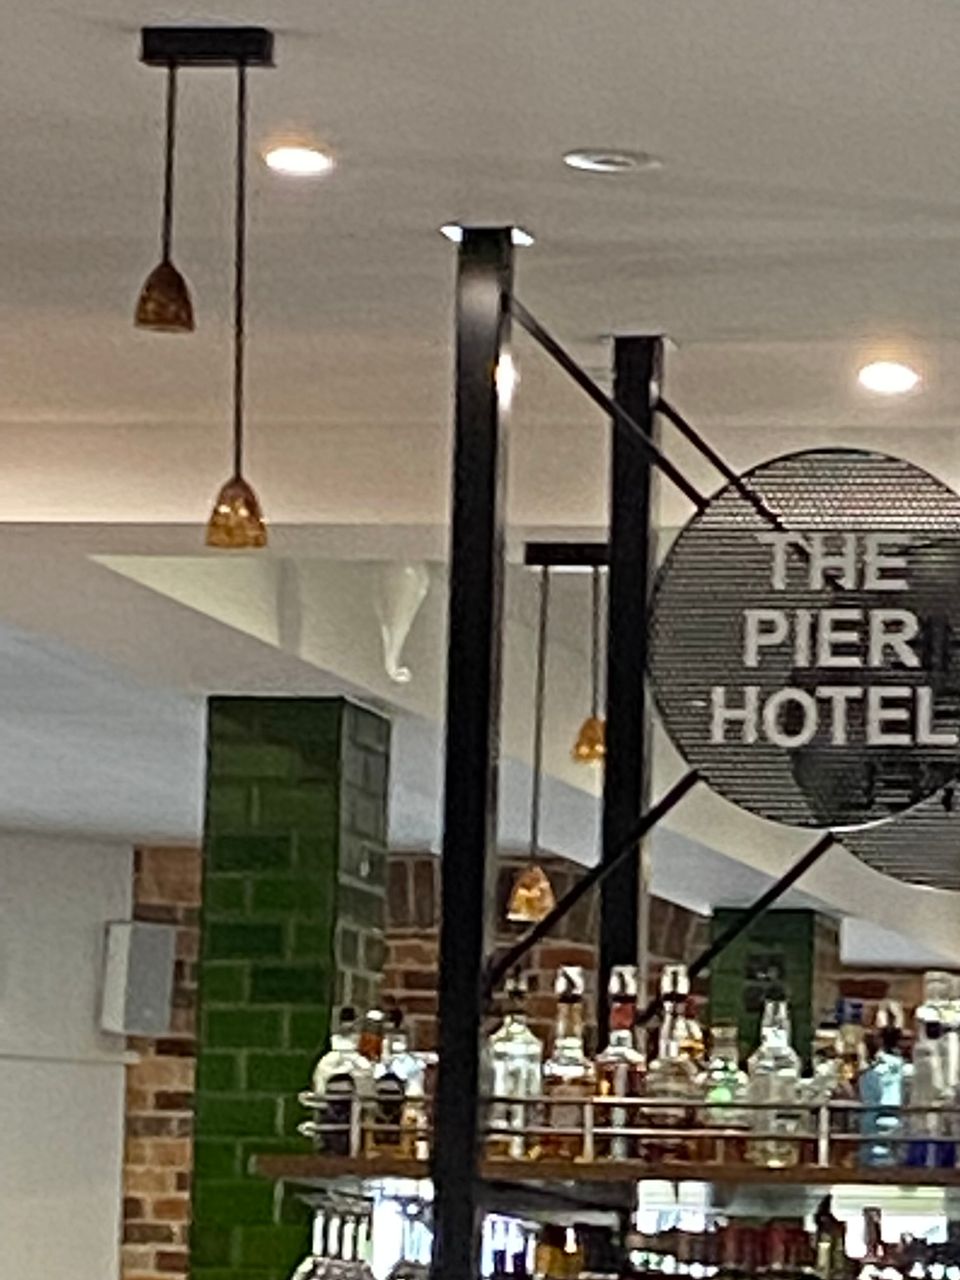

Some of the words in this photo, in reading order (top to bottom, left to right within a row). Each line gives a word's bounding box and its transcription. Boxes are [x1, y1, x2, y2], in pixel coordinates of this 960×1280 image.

[754, 532, 909, 590] THE
[742, 608, 921, 667] PIER
[710, 685, 960, 748] HOTEL
